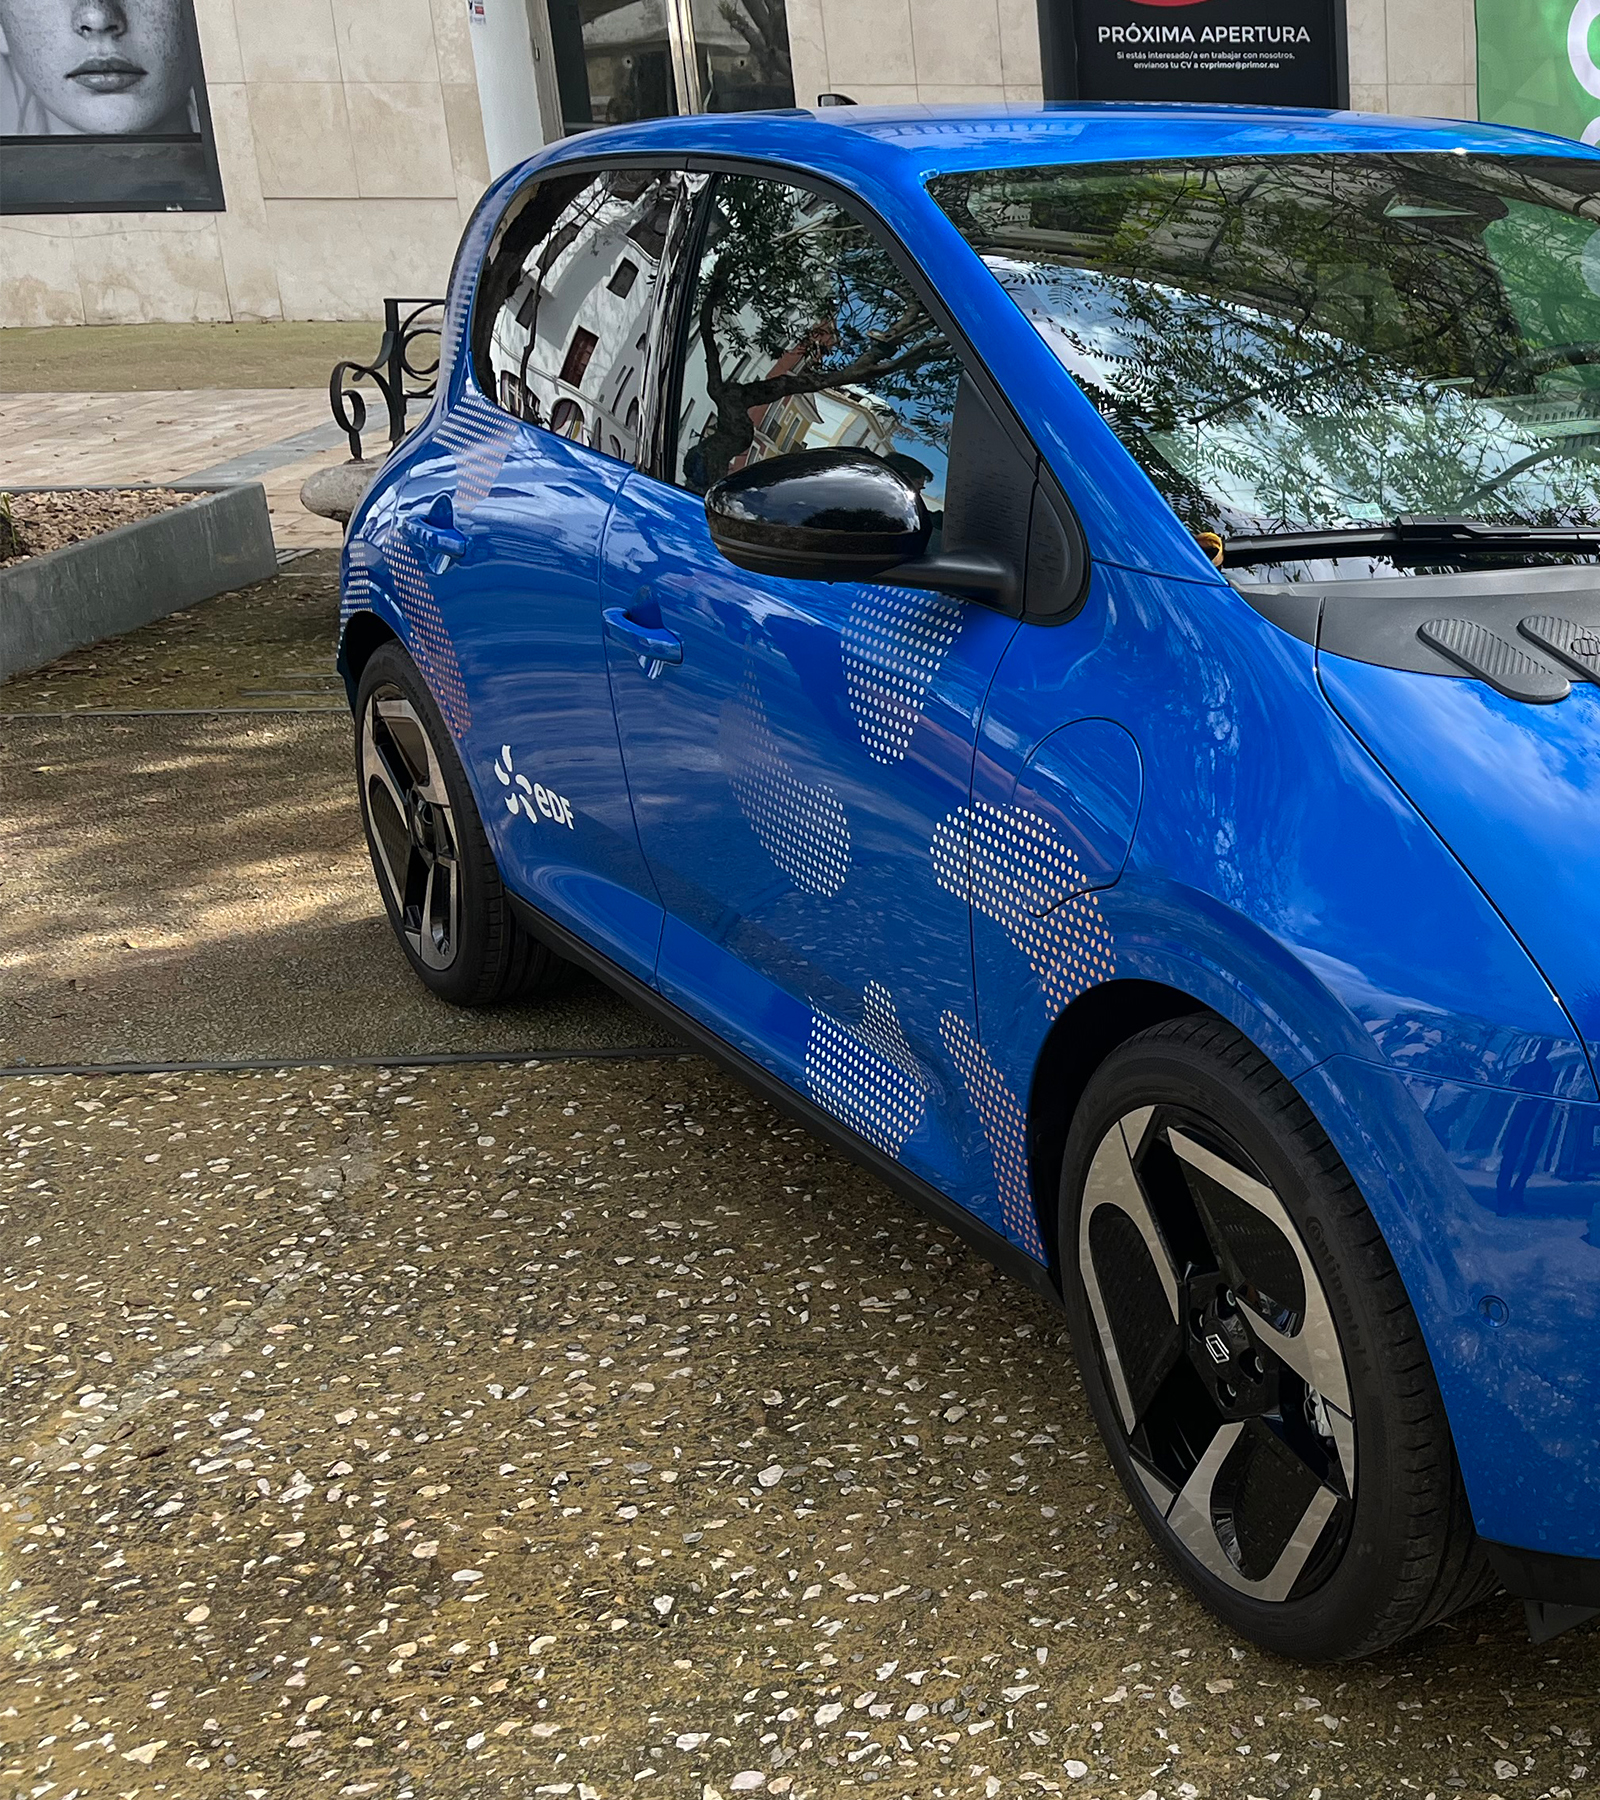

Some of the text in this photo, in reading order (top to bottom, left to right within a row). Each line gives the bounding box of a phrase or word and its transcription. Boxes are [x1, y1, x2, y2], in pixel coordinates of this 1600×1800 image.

[1097, 22, 1311, 43] PRÓXIMA APERTURA
[1116, 51, 1125, 59] Si
[1125, 51, 1147, 59] estás
[1147, 50, 1198, 60] interesado/a
[1211, 51, 1241, 60] trabajar
[1259, 51, 1296, 60] nosotros,
[1170, 61, 1179, 69] tu
[1180, 61, 1192, 69] CV
[1199, 61, 1280, 70] cvprimor@primor.eu
